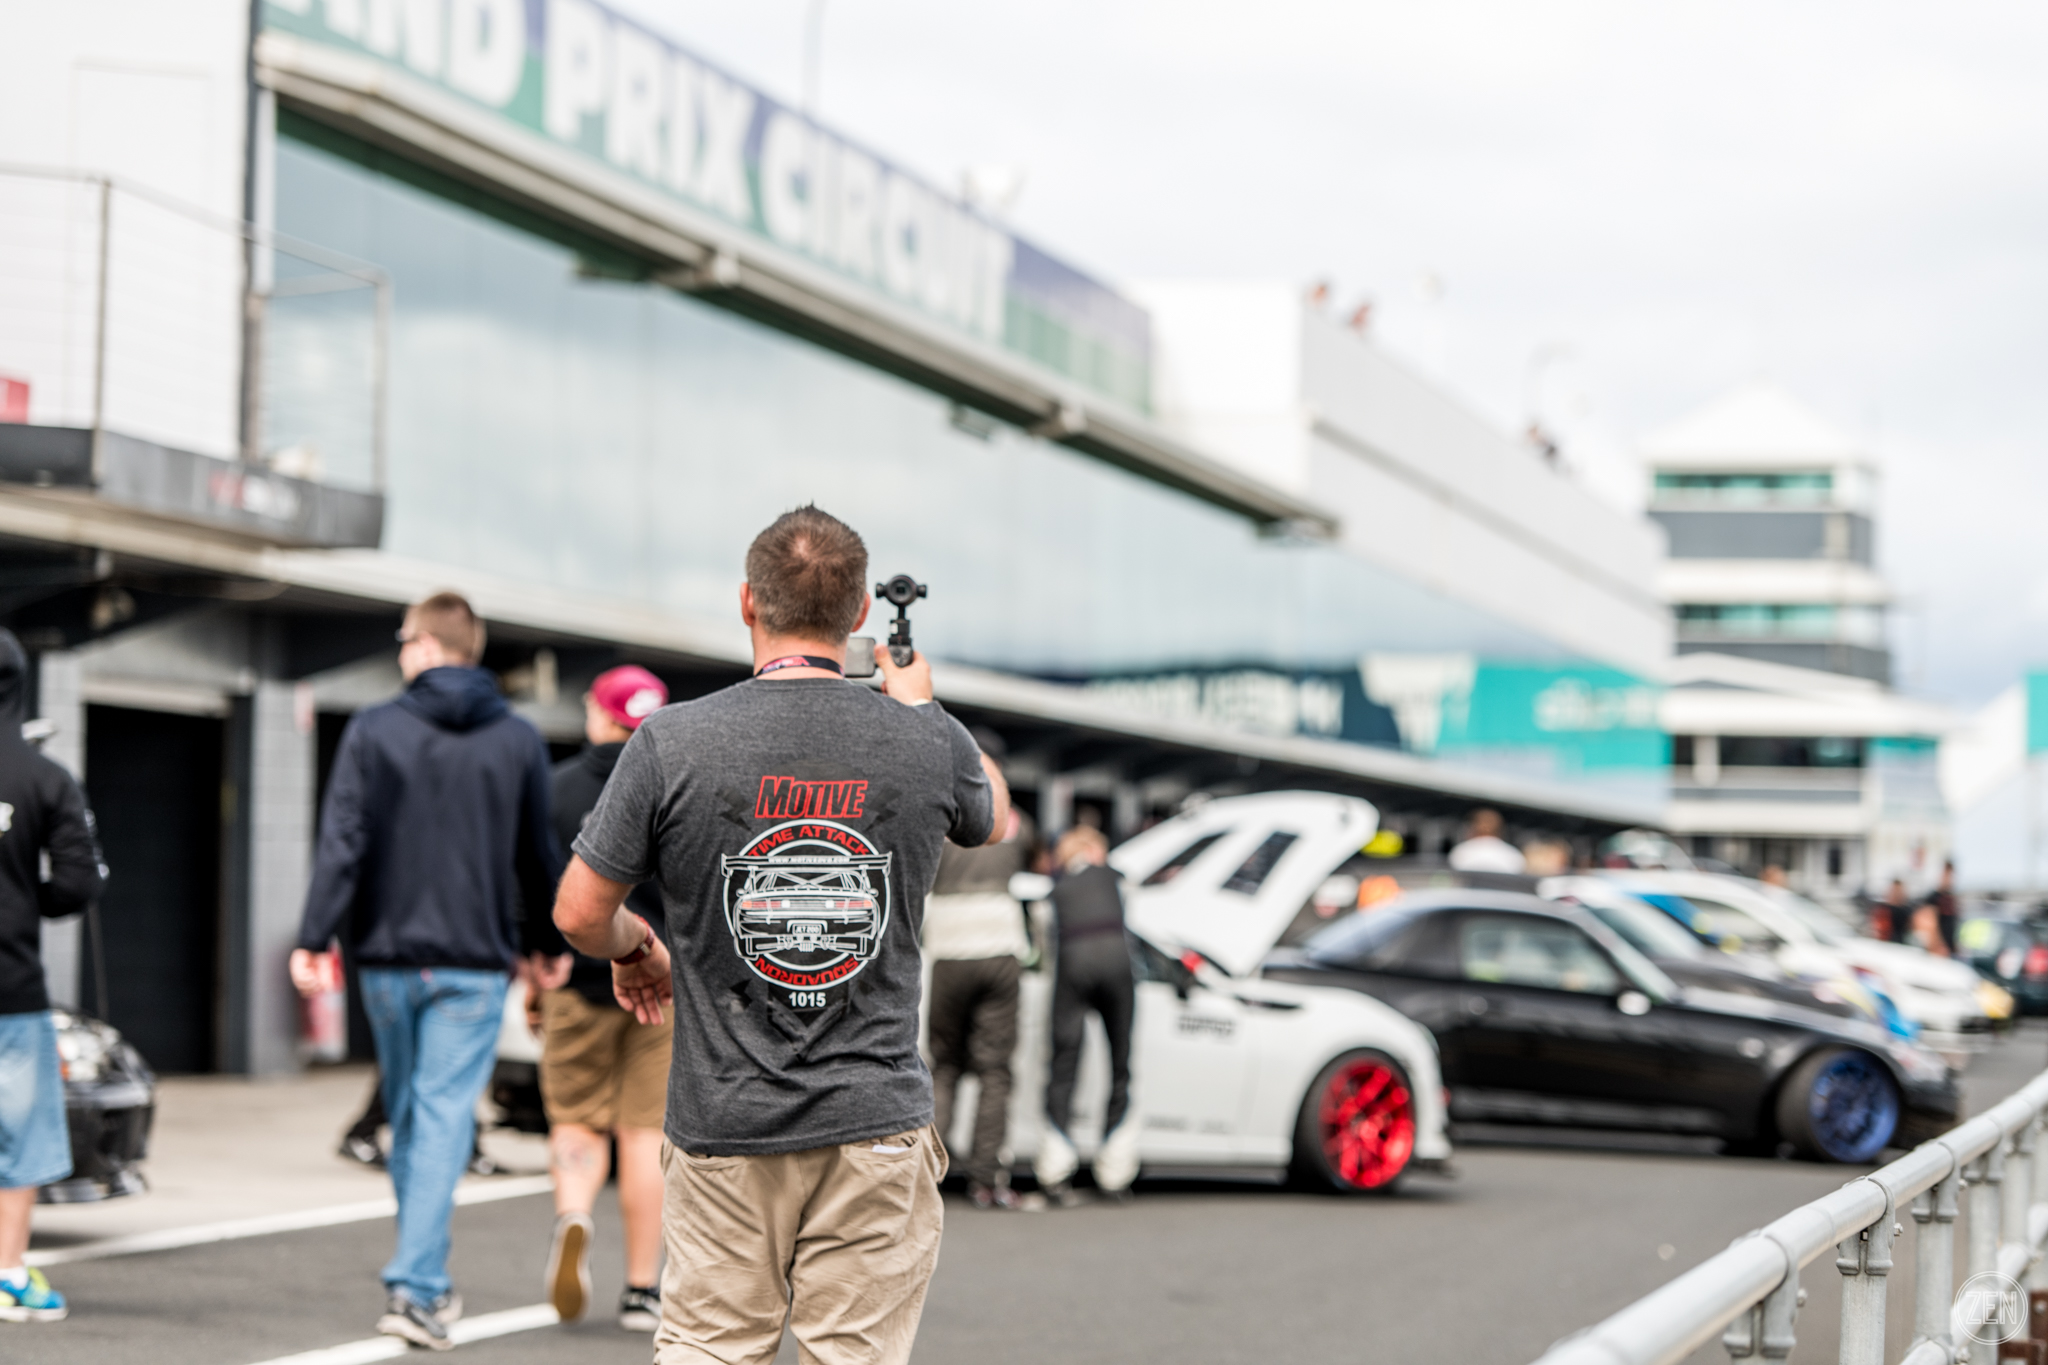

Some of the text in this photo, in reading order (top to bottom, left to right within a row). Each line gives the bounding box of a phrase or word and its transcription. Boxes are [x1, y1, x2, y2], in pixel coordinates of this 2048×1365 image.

[755, 776, 868, 818] MOTIVE
[747, 825, 870, 857] TIME ATTACK
[754, 957, 859, 986] SQUADRON
[789, 992, 827, 1008] 1015
